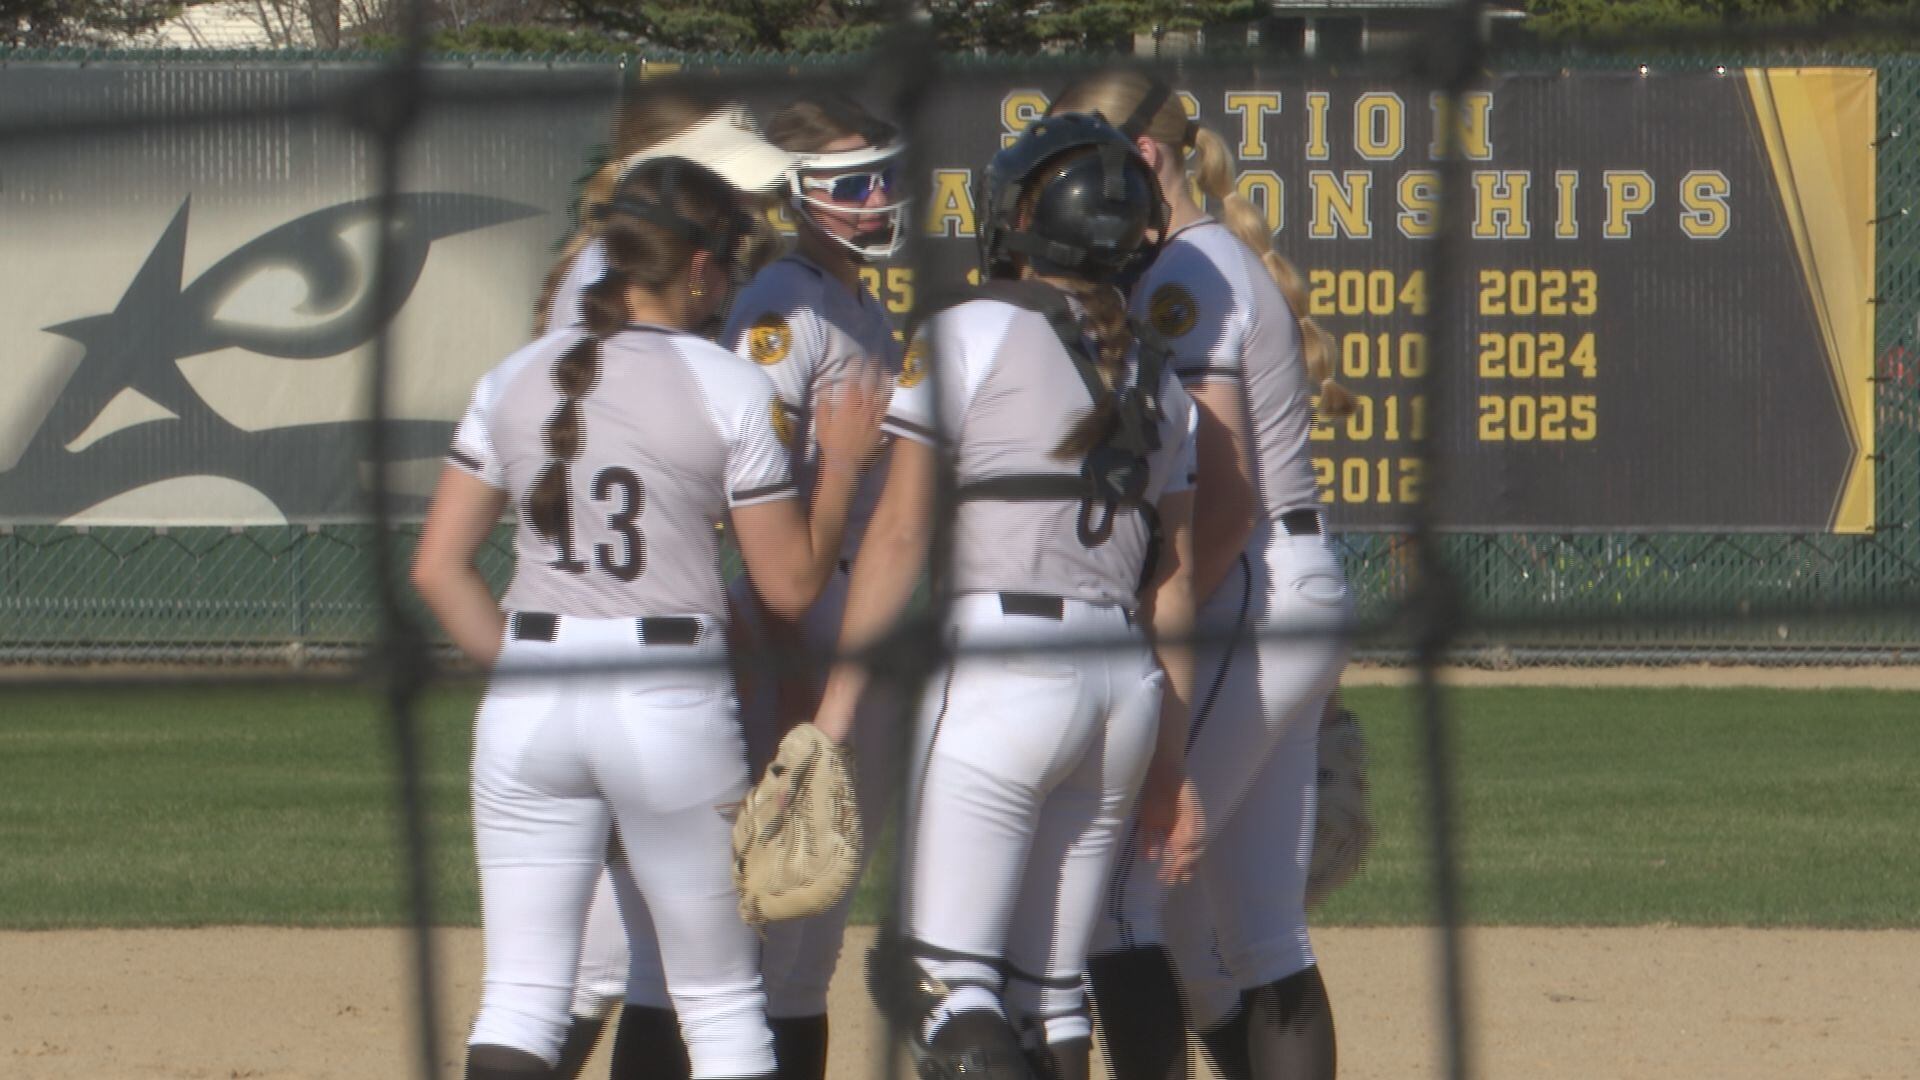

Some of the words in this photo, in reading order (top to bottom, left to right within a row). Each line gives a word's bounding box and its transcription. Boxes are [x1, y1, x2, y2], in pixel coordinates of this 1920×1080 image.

[1001, 91, 1493, 160] STION
[763, 170, 1731, 239] AONSHIPS
[1309, 269, 1427, 315] 2004
[1479, 269, 1598, 315] 2023
[1342, 332, 1427, 378] 010
[1479, 332, 1598, 378] 2024
[1479, 395, 1598, 441] 2025
[1311, 457, 1422, 503] 2012
[546, 464, 648, 582] 13
